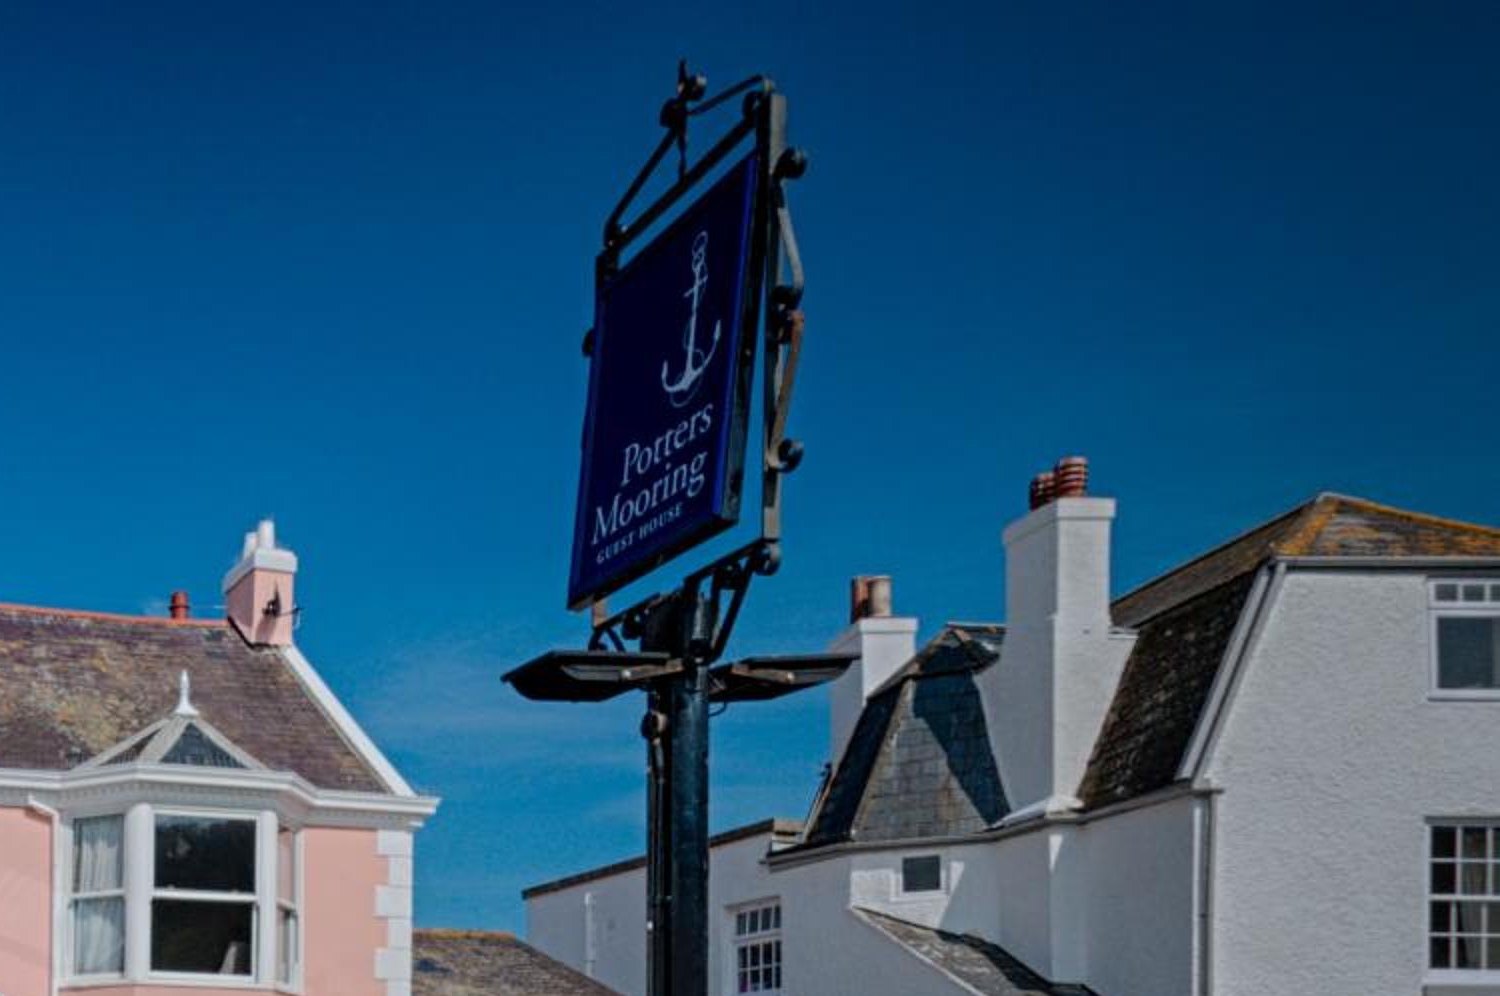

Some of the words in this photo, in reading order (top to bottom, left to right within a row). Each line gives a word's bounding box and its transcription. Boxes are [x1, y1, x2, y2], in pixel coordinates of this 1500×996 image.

[620, 402, 714, 487] Potters
[592, 451, 708, 545] Mooring
[596, 531, 635, 564] GUEST
[639, 502, 683, 540] HOUSE
